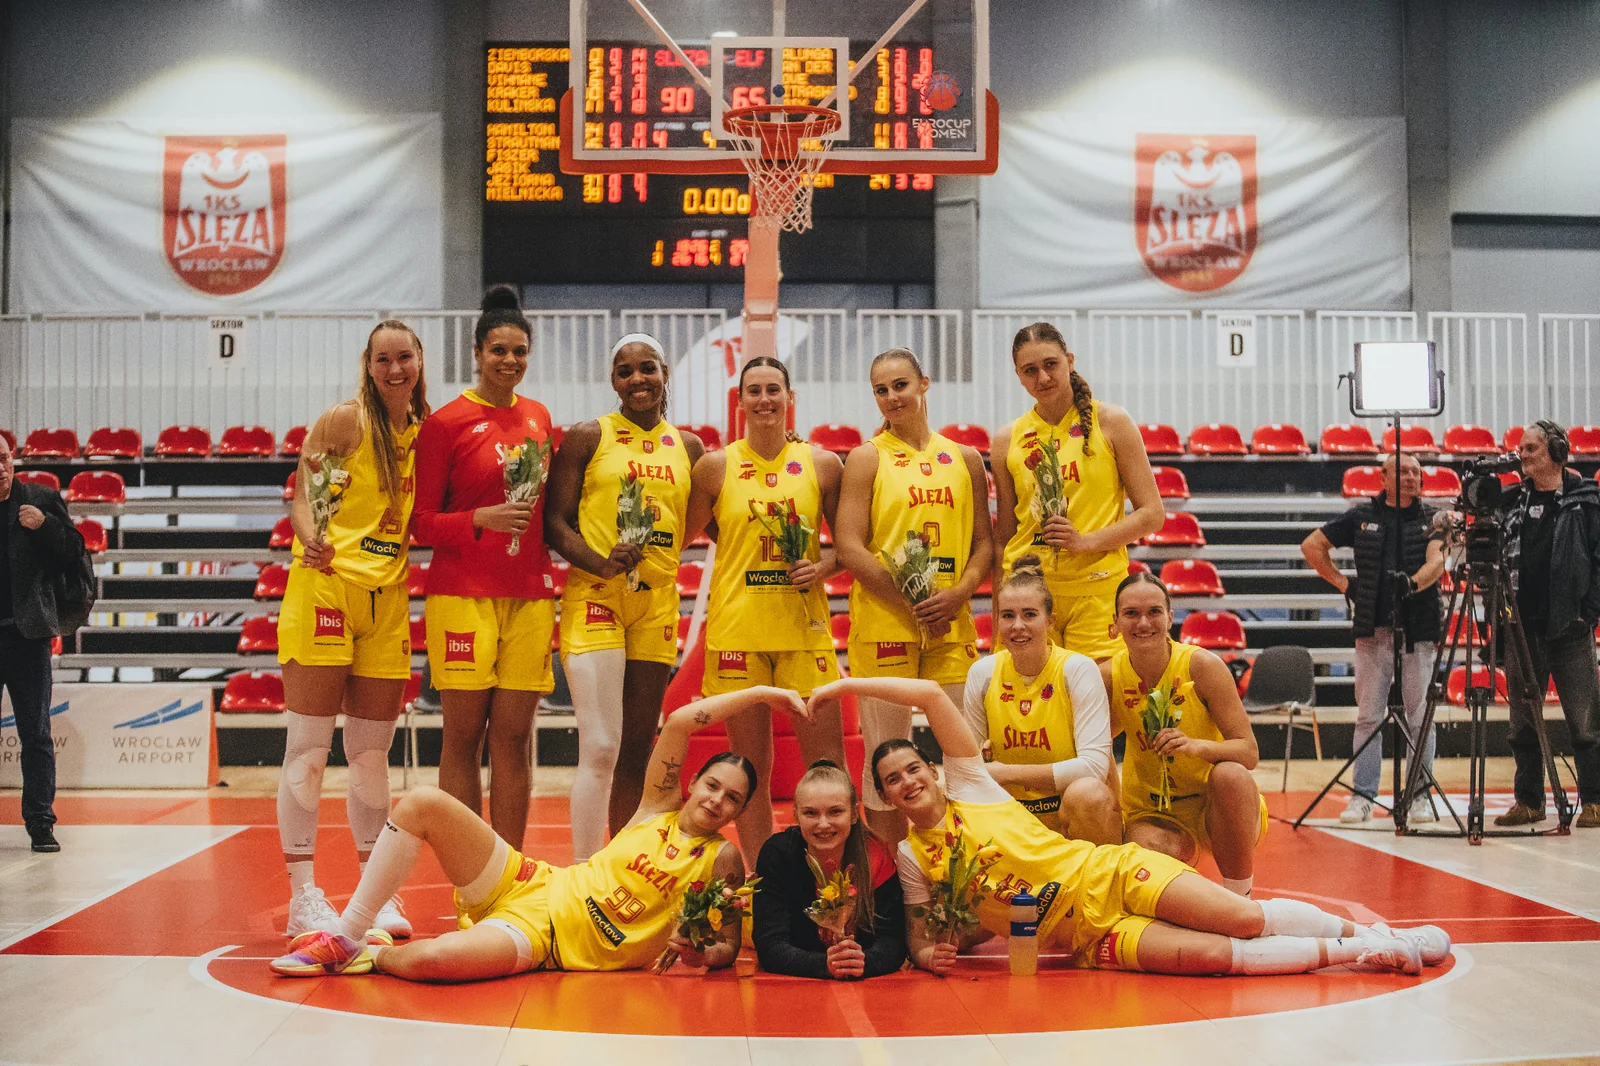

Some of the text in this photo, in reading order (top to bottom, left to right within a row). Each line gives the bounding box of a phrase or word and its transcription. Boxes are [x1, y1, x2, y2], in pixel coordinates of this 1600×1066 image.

[488, 61, 532, 74] DAVIS
[661, 86, 694, 113] 90
[732, 86, 767, 109] 65
[912, 118, 972, 129] EUROCUP
[917, 129, 966, 139] WOMEN
[487, 136, 560, 150] STRAUTMAN
[210, 319, 244, 330] SEKTOR
[220, 334, 235, 359] D
[1230, 333, 1244, 357] D
[627, 460, 676, 486] ŚLĘZA
[908, 484, 955, 510] ŚLĘZA
[364, 539, 399, 555] Wrocła
[319, 614, 342, 628] ibis
[448, 639, 471, 653] ibis
[112, 736, 203, 749] WROCLAW
[1003, 724, 1052, 752] ŚLĘZA
[118, 752, 196, 764] AIRPORT
[1020, 800, 1059, 813] rocław
[625, 853, 679, 900] ŚLĘZA
[604, 885, 646, 925] 99
[1037, 883, 1057, 914] ocław
[586, 898, 621, 942] Wrocław
[1100, 937, 1111, 960] ibis
